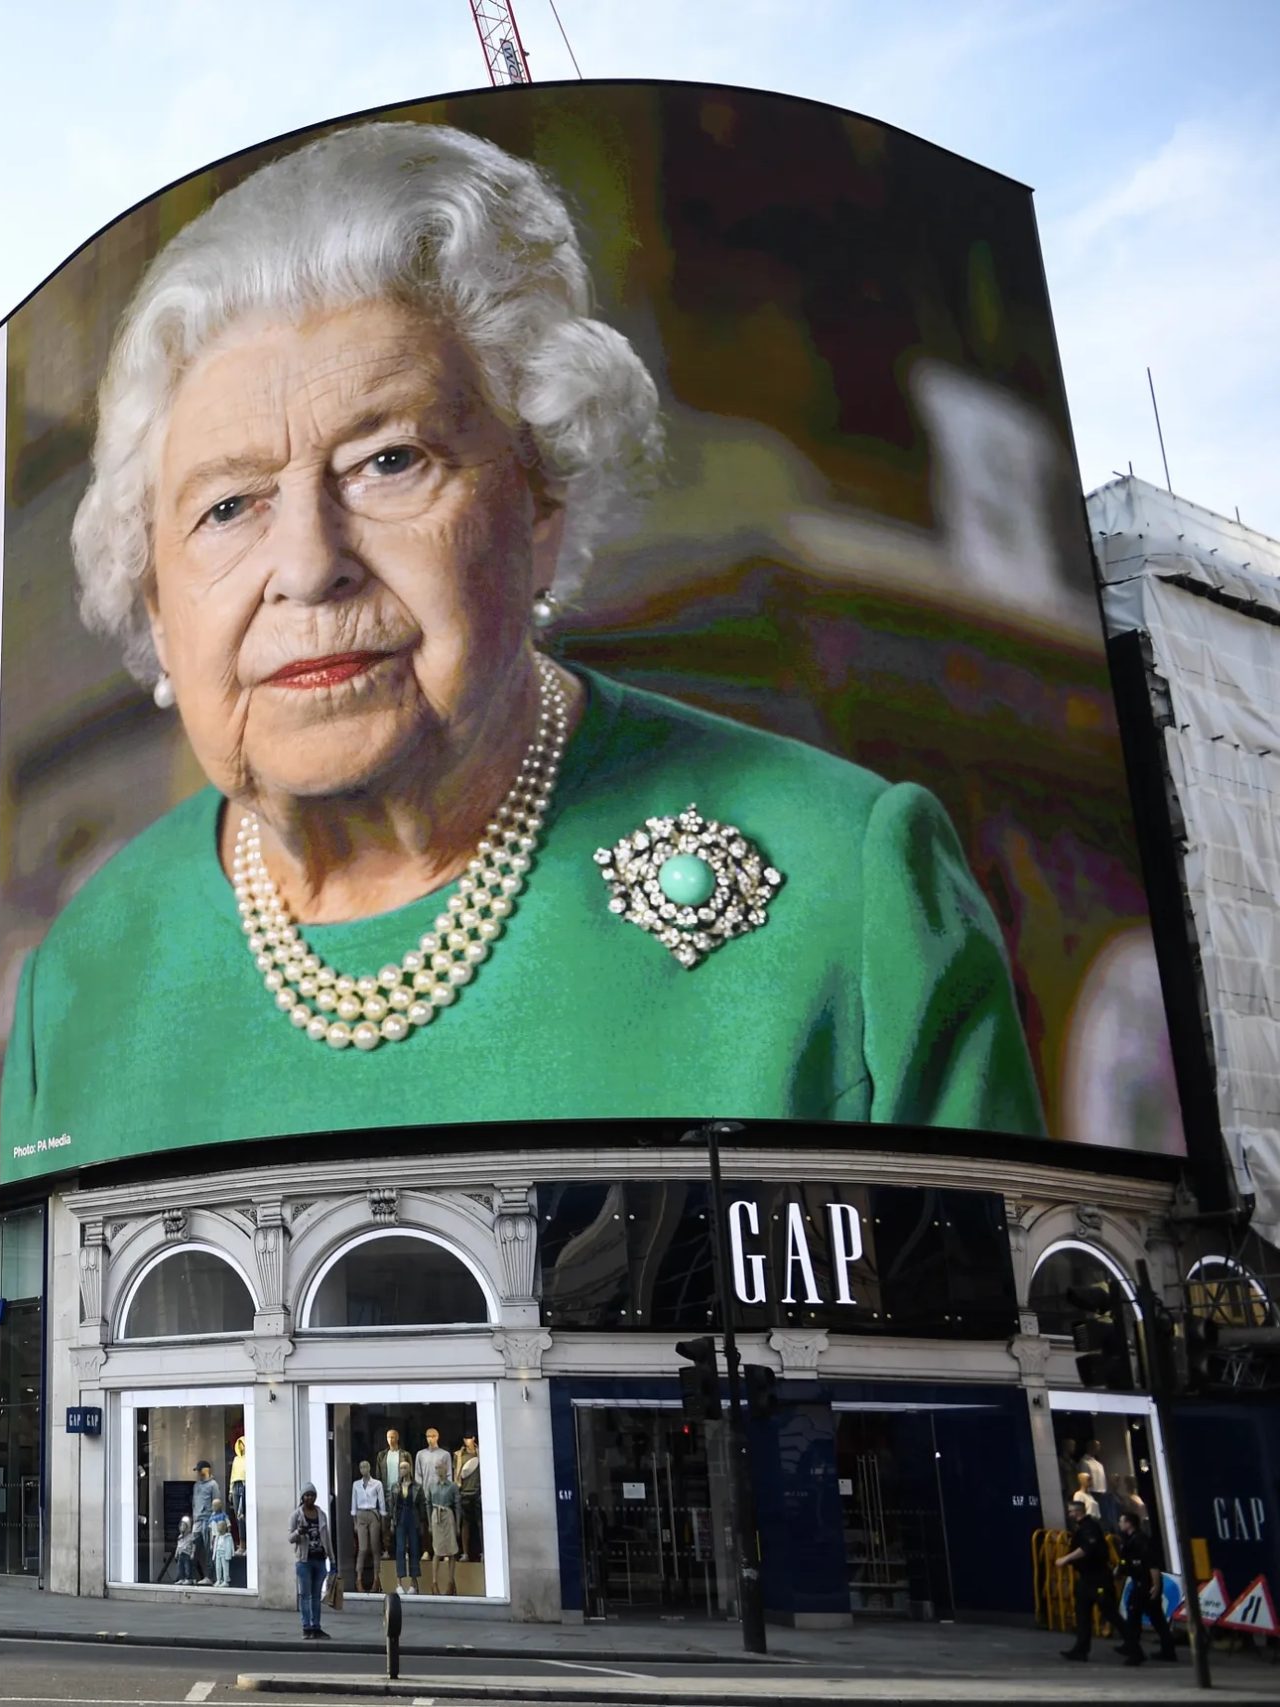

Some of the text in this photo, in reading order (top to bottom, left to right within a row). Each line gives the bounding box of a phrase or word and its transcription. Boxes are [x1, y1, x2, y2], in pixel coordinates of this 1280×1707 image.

[13, 1132, 72, 1159] Photo: PA Media
[728, 1200, 863, 1305] GAP
[69, 1413, 81, 1427] GAP
[86, 1413, 99, 1427] GAP
[1213, 1496, 1266, 1541] GAP
